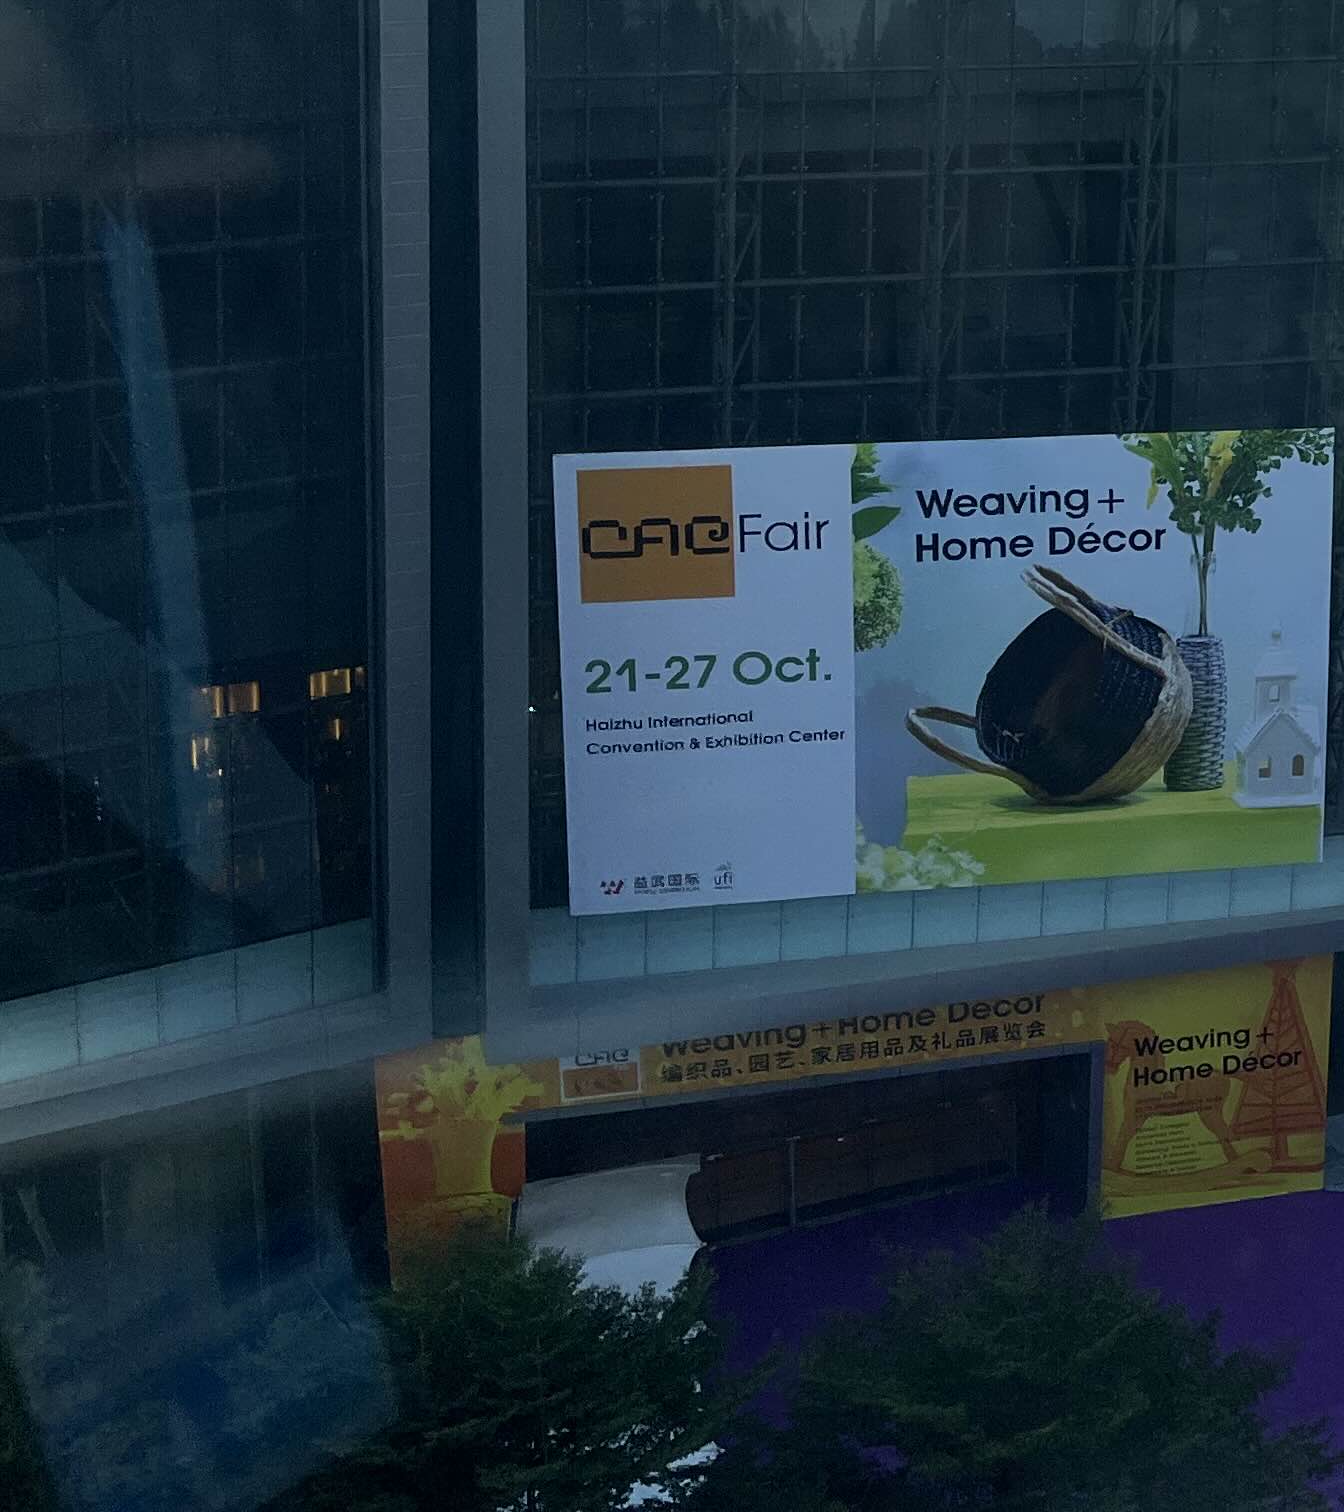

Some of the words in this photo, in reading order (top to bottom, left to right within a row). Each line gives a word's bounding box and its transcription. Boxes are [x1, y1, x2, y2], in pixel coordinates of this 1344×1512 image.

[915, 484, 1089, 519] Weaving
[915, 533, 1034, 562] Home
[1048, 522, 1167, 555] Décor
[584, 654, 717, 694] 21-27
[732, 648, 832, 685] Oct.
[586, 716, 643, 732] Haizhu
[648, 710, 753, 729] International
[586, 739, 684, 755] Convention
[689, 737, 700, 750] &
[705, 732, 784, 749] Exhibition
[788, 729, 845, 743] Center
[662, 1023, 806, 1058] Weaving
[839, 1005, 936, 1036] Home
[1134, 1027, 1250, 1057] Weaving
[1133, 1061, 1213, 1088] Home
[1222, 1050, 1302, 1076] Décor
